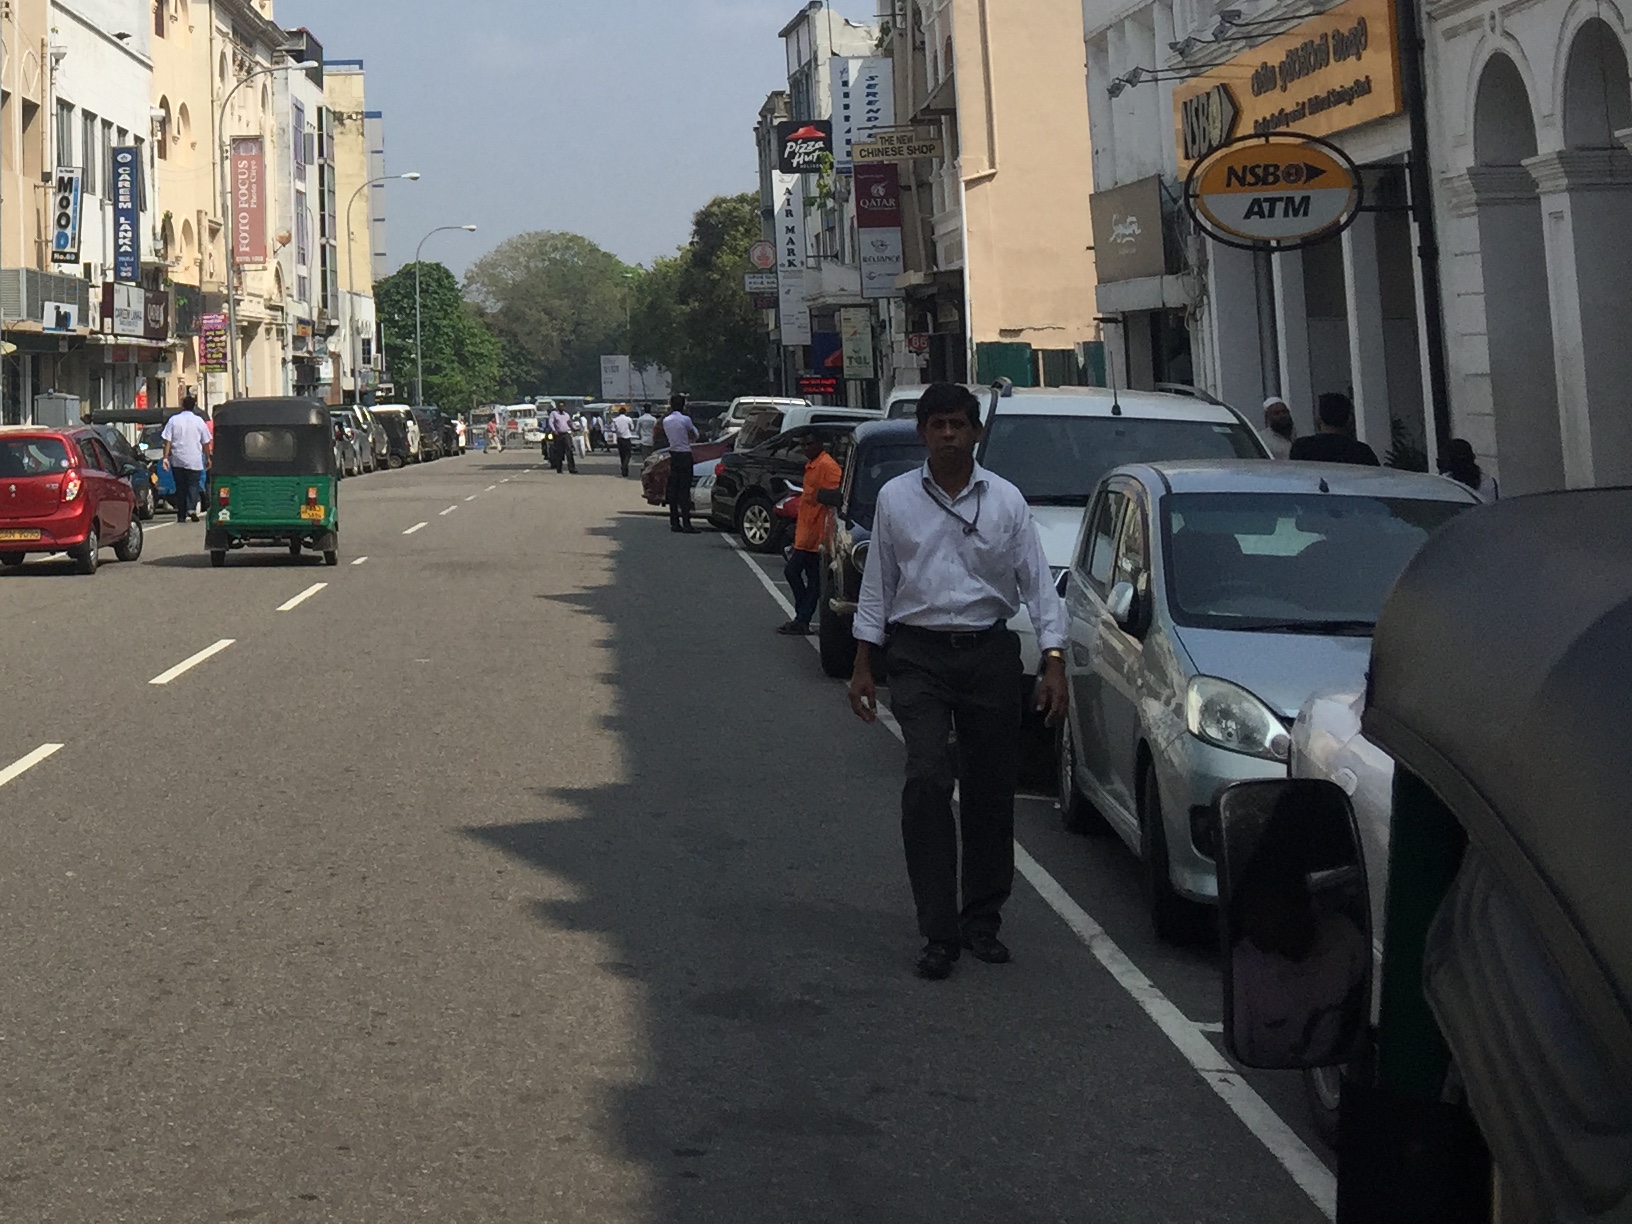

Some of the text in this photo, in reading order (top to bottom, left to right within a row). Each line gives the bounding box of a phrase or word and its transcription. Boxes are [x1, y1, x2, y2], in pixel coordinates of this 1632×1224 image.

[879, 134, 914, 146] THE NEW
[1182, 90, 1211, 161] NSB
[783, 139, 825, 158] Pizza
[791, 149, 822, 168] Hut
[859, 143, 936, 158] CHINESE SHOP
[117, 166, 132, 209] CAREEM
[237, 159, 249, 209] FOCUS
[1225, 163, 1282, 188] NSB
[54, 175, 74, 250] MOOD
[783, 186, 794, 218] AIR
[860, 198, 896, 209] QATAR
[1243, 194, 1312, 220] ATM
[118, 216, 133, 253] LANKA
[238, 211, 250, 252] FOTO
[784, 225, 798, 269] MARK
